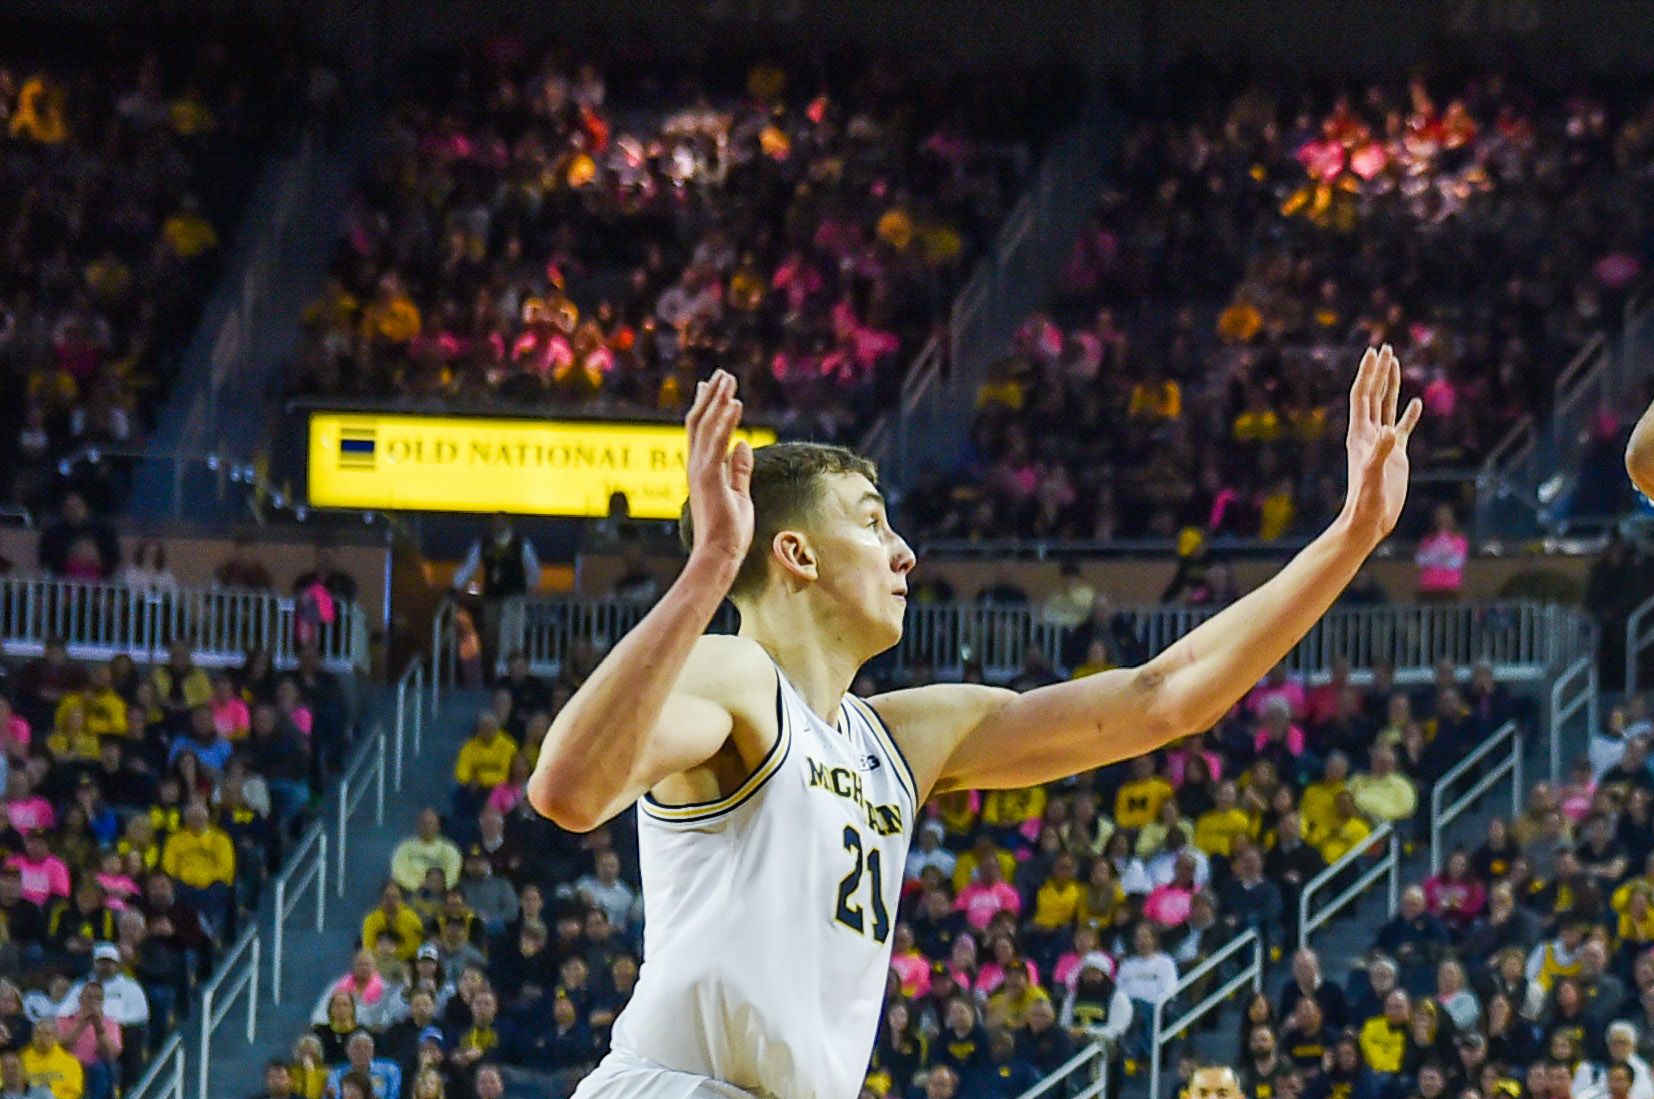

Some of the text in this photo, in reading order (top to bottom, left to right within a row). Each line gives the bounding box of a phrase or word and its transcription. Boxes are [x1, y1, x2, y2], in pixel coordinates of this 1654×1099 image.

[388, 438, 688, 471] OLD NATIONAL BA
[834, 824, 890, 944] 21
